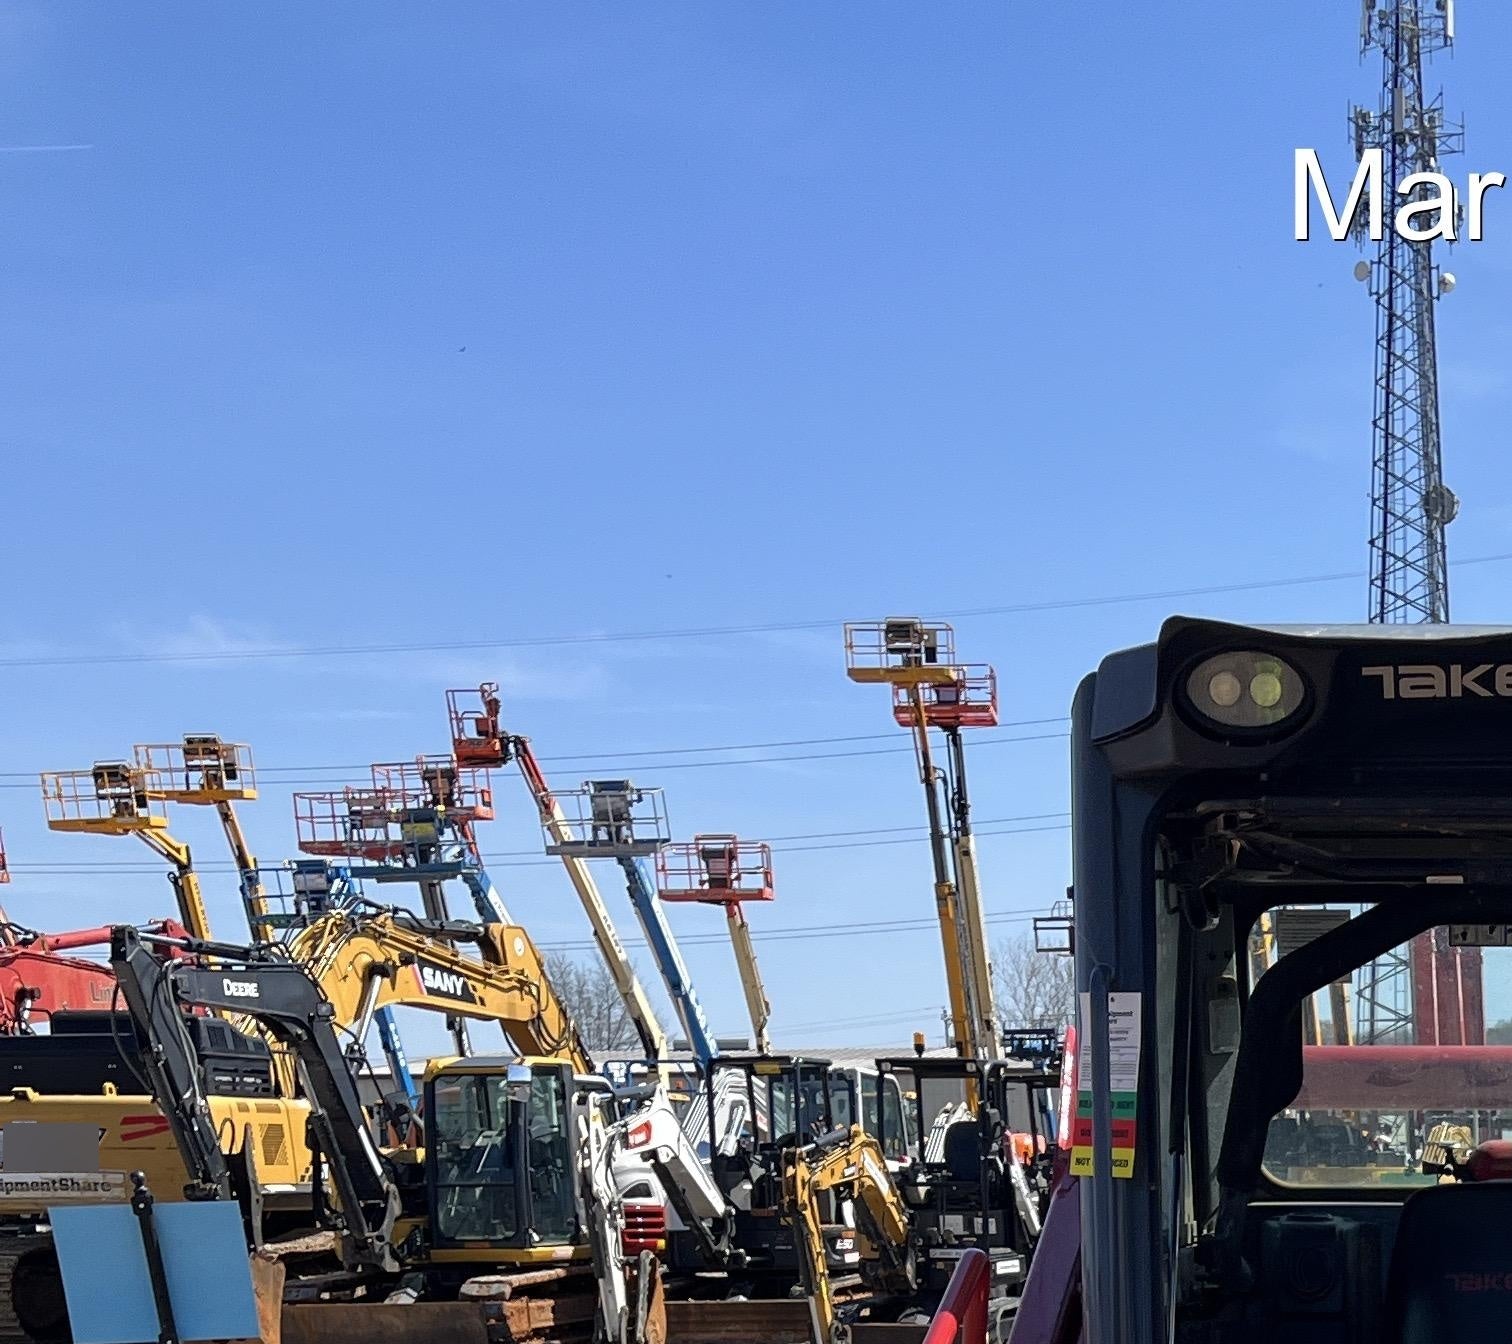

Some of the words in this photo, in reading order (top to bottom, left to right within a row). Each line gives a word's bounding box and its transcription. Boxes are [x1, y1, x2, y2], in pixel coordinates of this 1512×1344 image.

[222, 978, 260, 998] DEERE
[422, 966, 465, 996] SANY
[0, 1177, 112, 1195] ipmentShare
